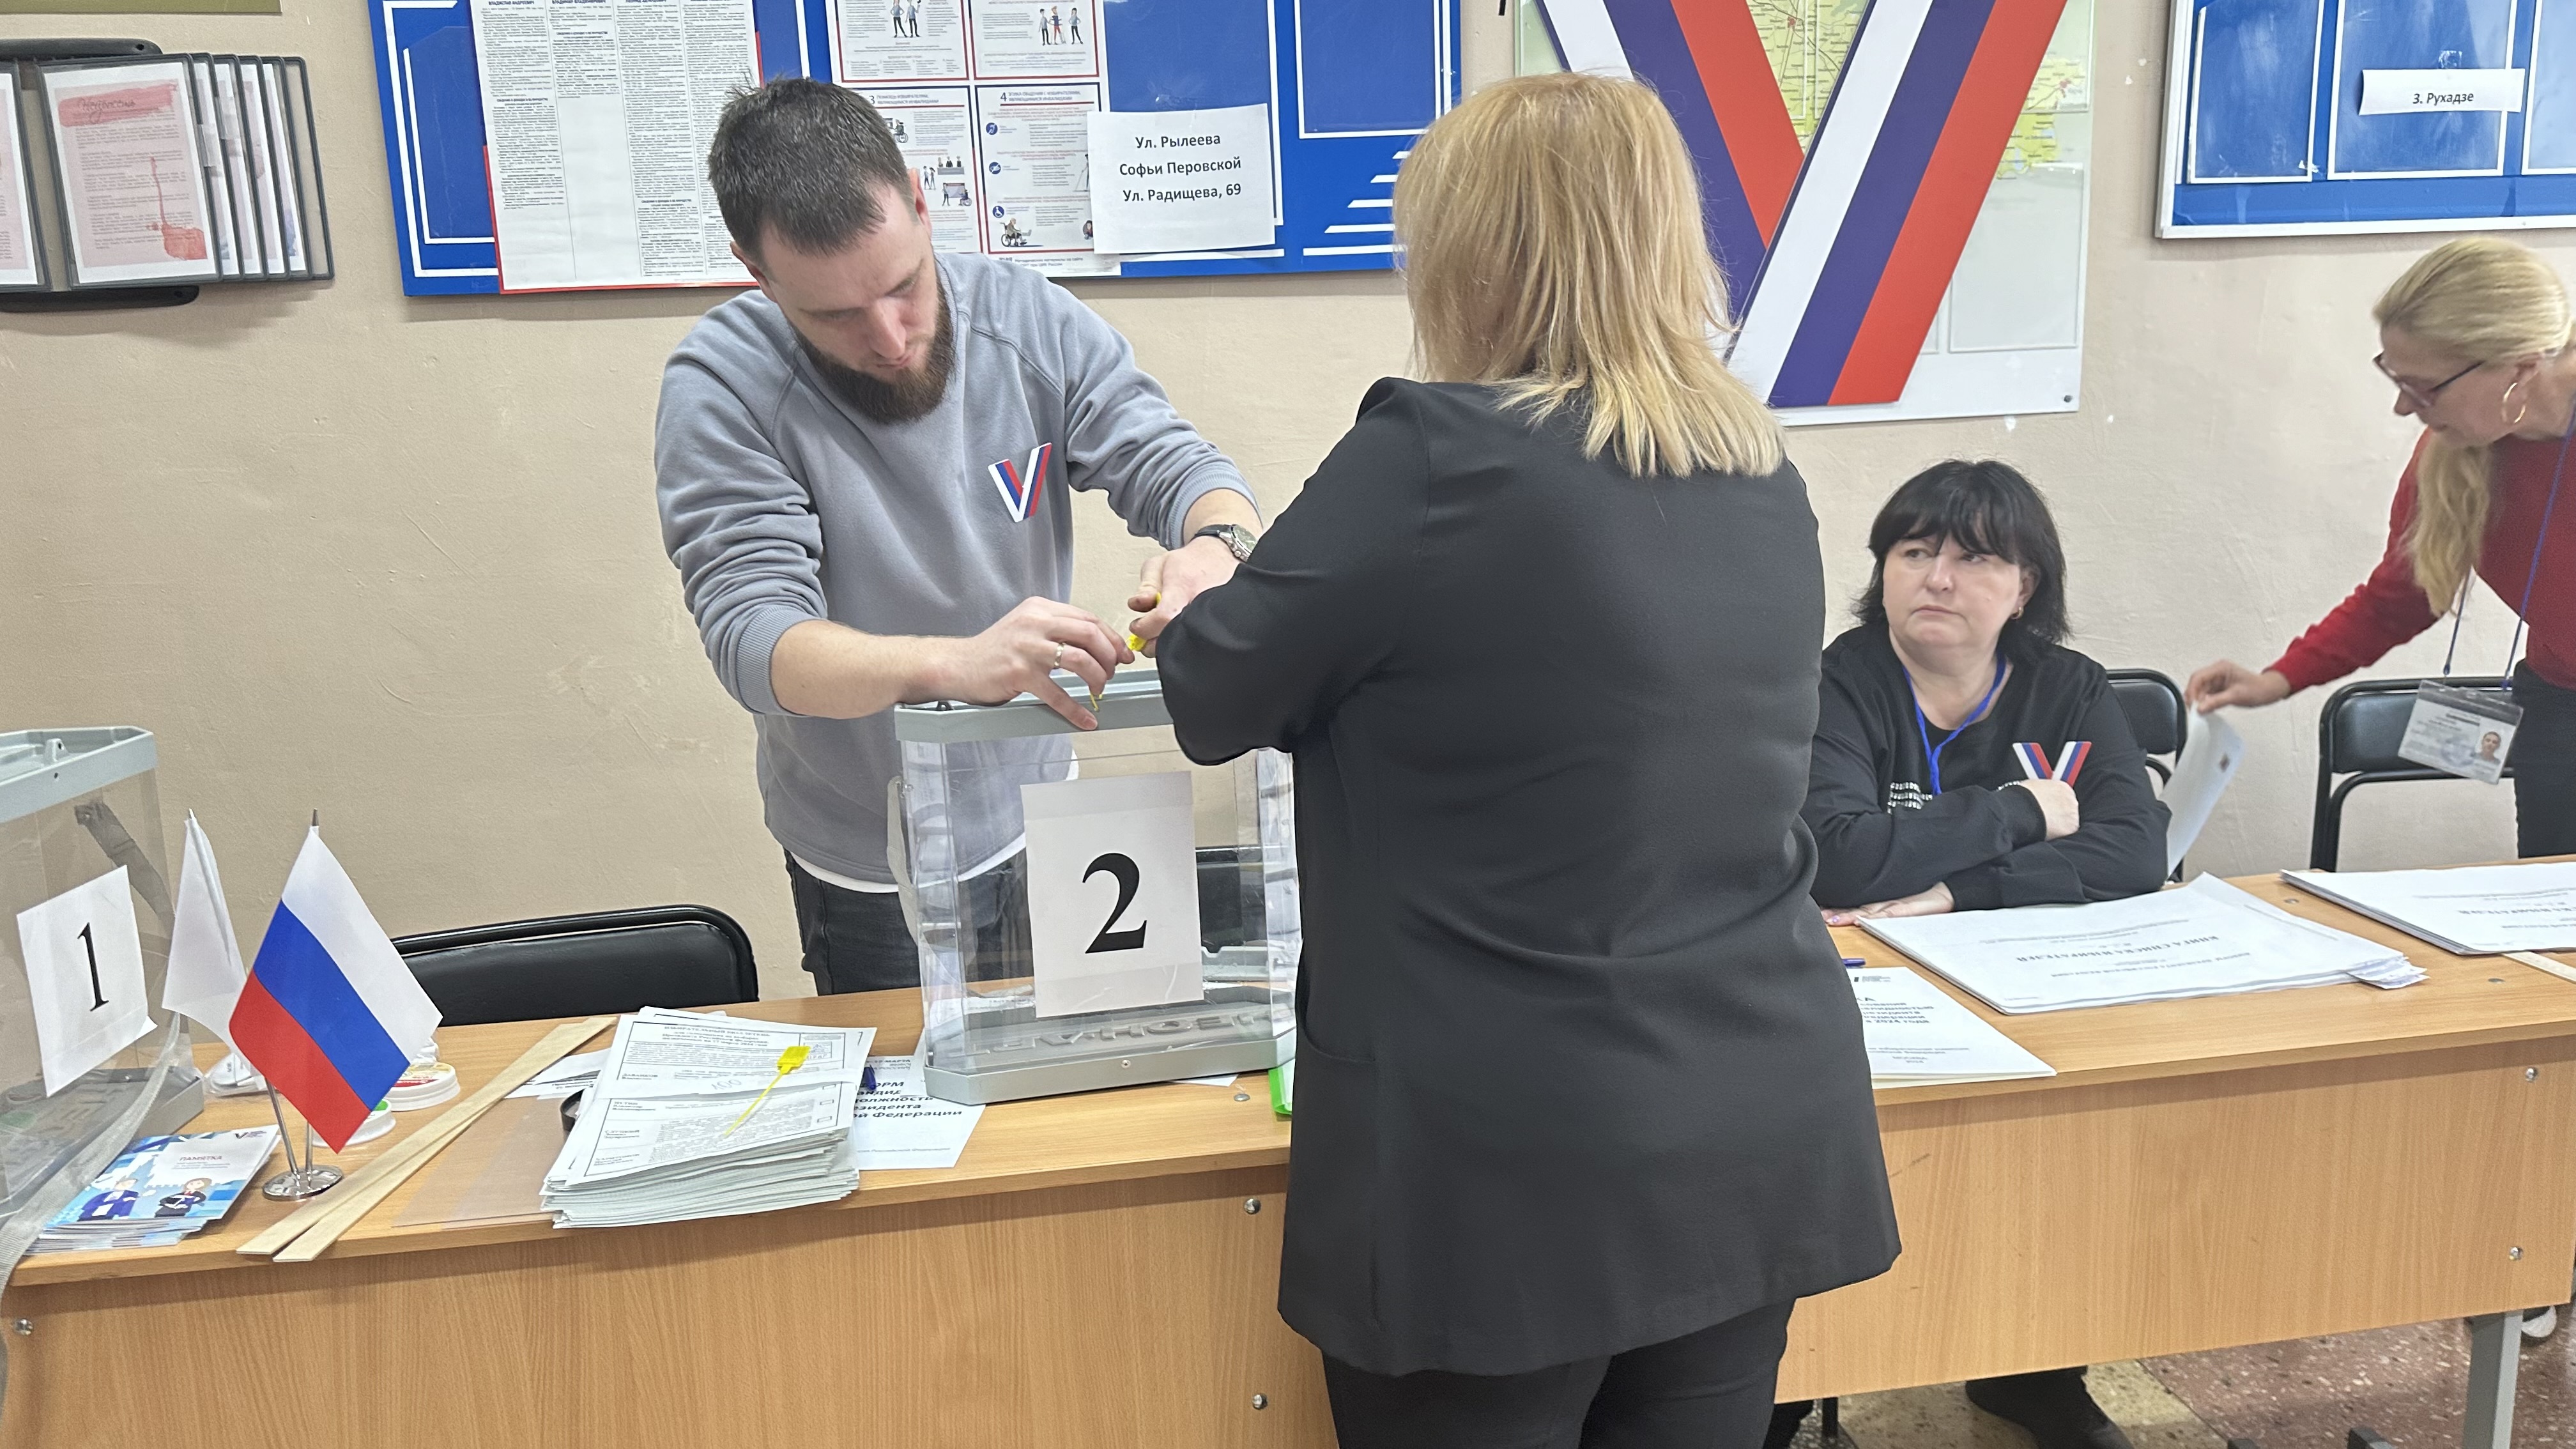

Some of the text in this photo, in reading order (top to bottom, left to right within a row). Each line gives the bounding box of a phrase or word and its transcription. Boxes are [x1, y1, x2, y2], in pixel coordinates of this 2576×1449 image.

[1000, 92, 1008, 102] 4
[2426, 92, 2474, 107] Рухадзе
[1135, 135, 1221, 149] Ул. Рылеева
[1119, 156, 1241, 178] Софьи Перовской
[1123, 183, 1241, 203] Ул. Радищева, 69
[1082, 852, 1148, 954] 2
[77, 921, 110, 1012] 1
[711, 1078, 742, 1091] 100
